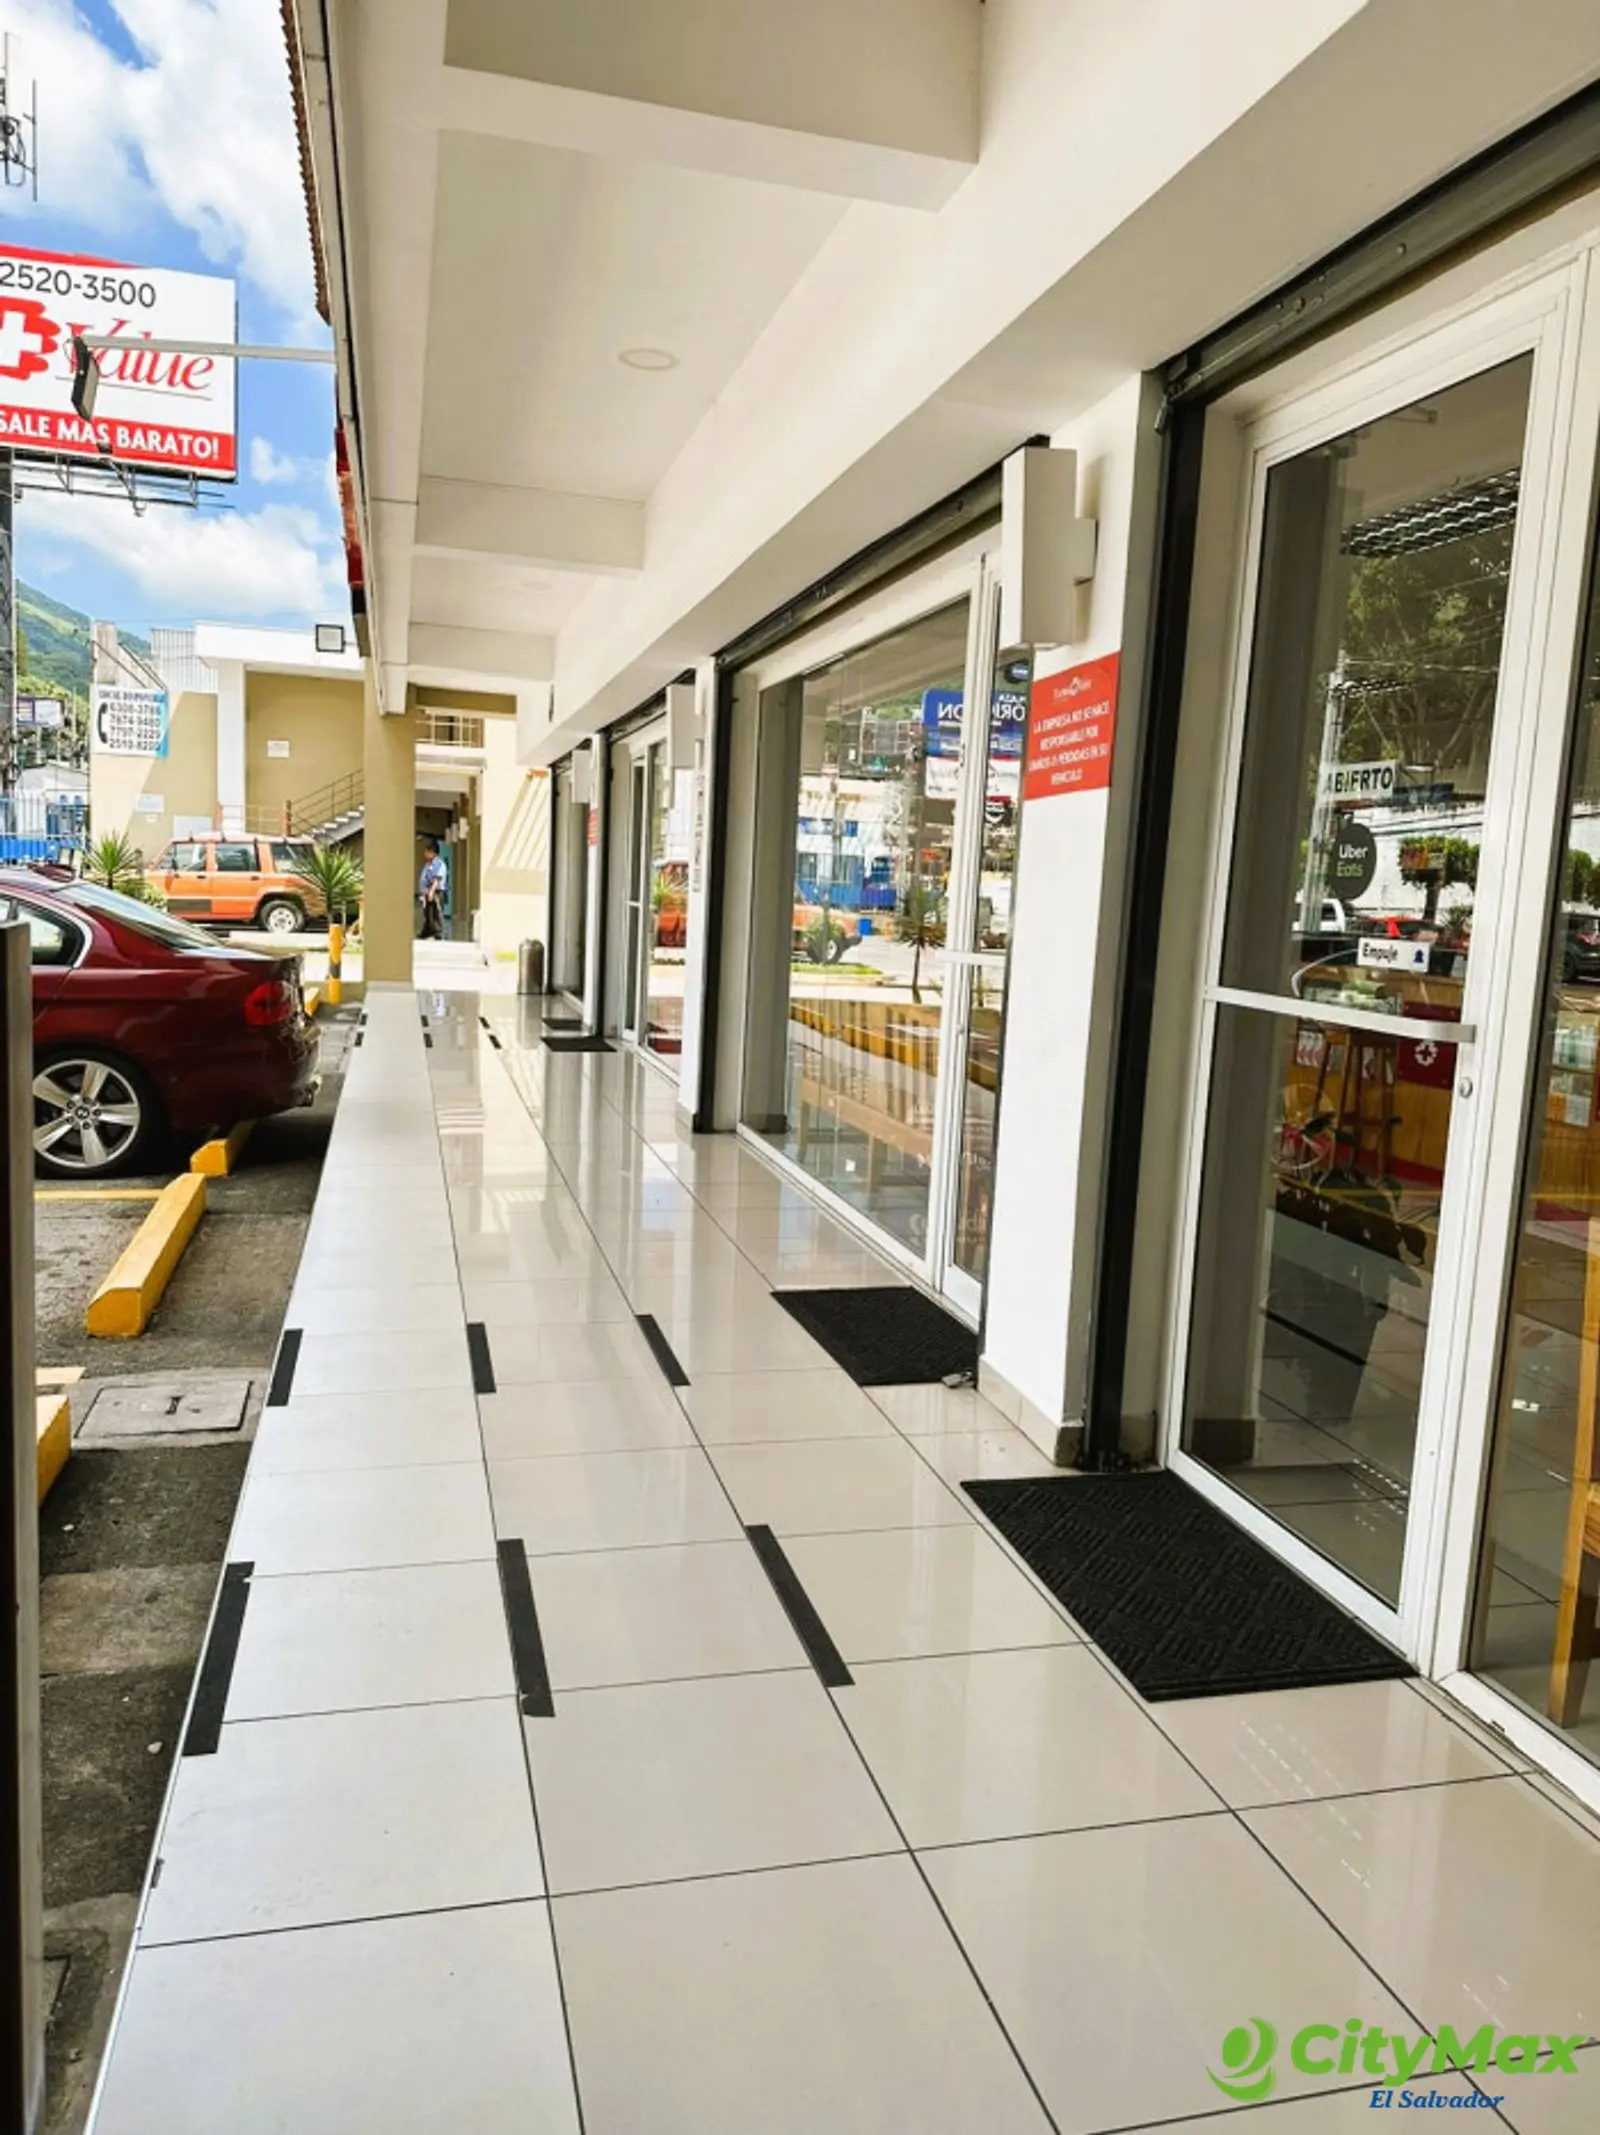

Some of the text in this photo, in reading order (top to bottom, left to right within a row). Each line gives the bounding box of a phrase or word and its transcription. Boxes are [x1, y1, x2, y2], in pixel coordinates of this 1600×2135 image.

[0, 261, 156, 308] 2520-3500
[116, 428, 219, 460] BARATO!
[1339, 844, 1368, 859] Uber
[1336, 861, 1364, 877] Eats
[1362, 942, 1398, 963] Empuje
